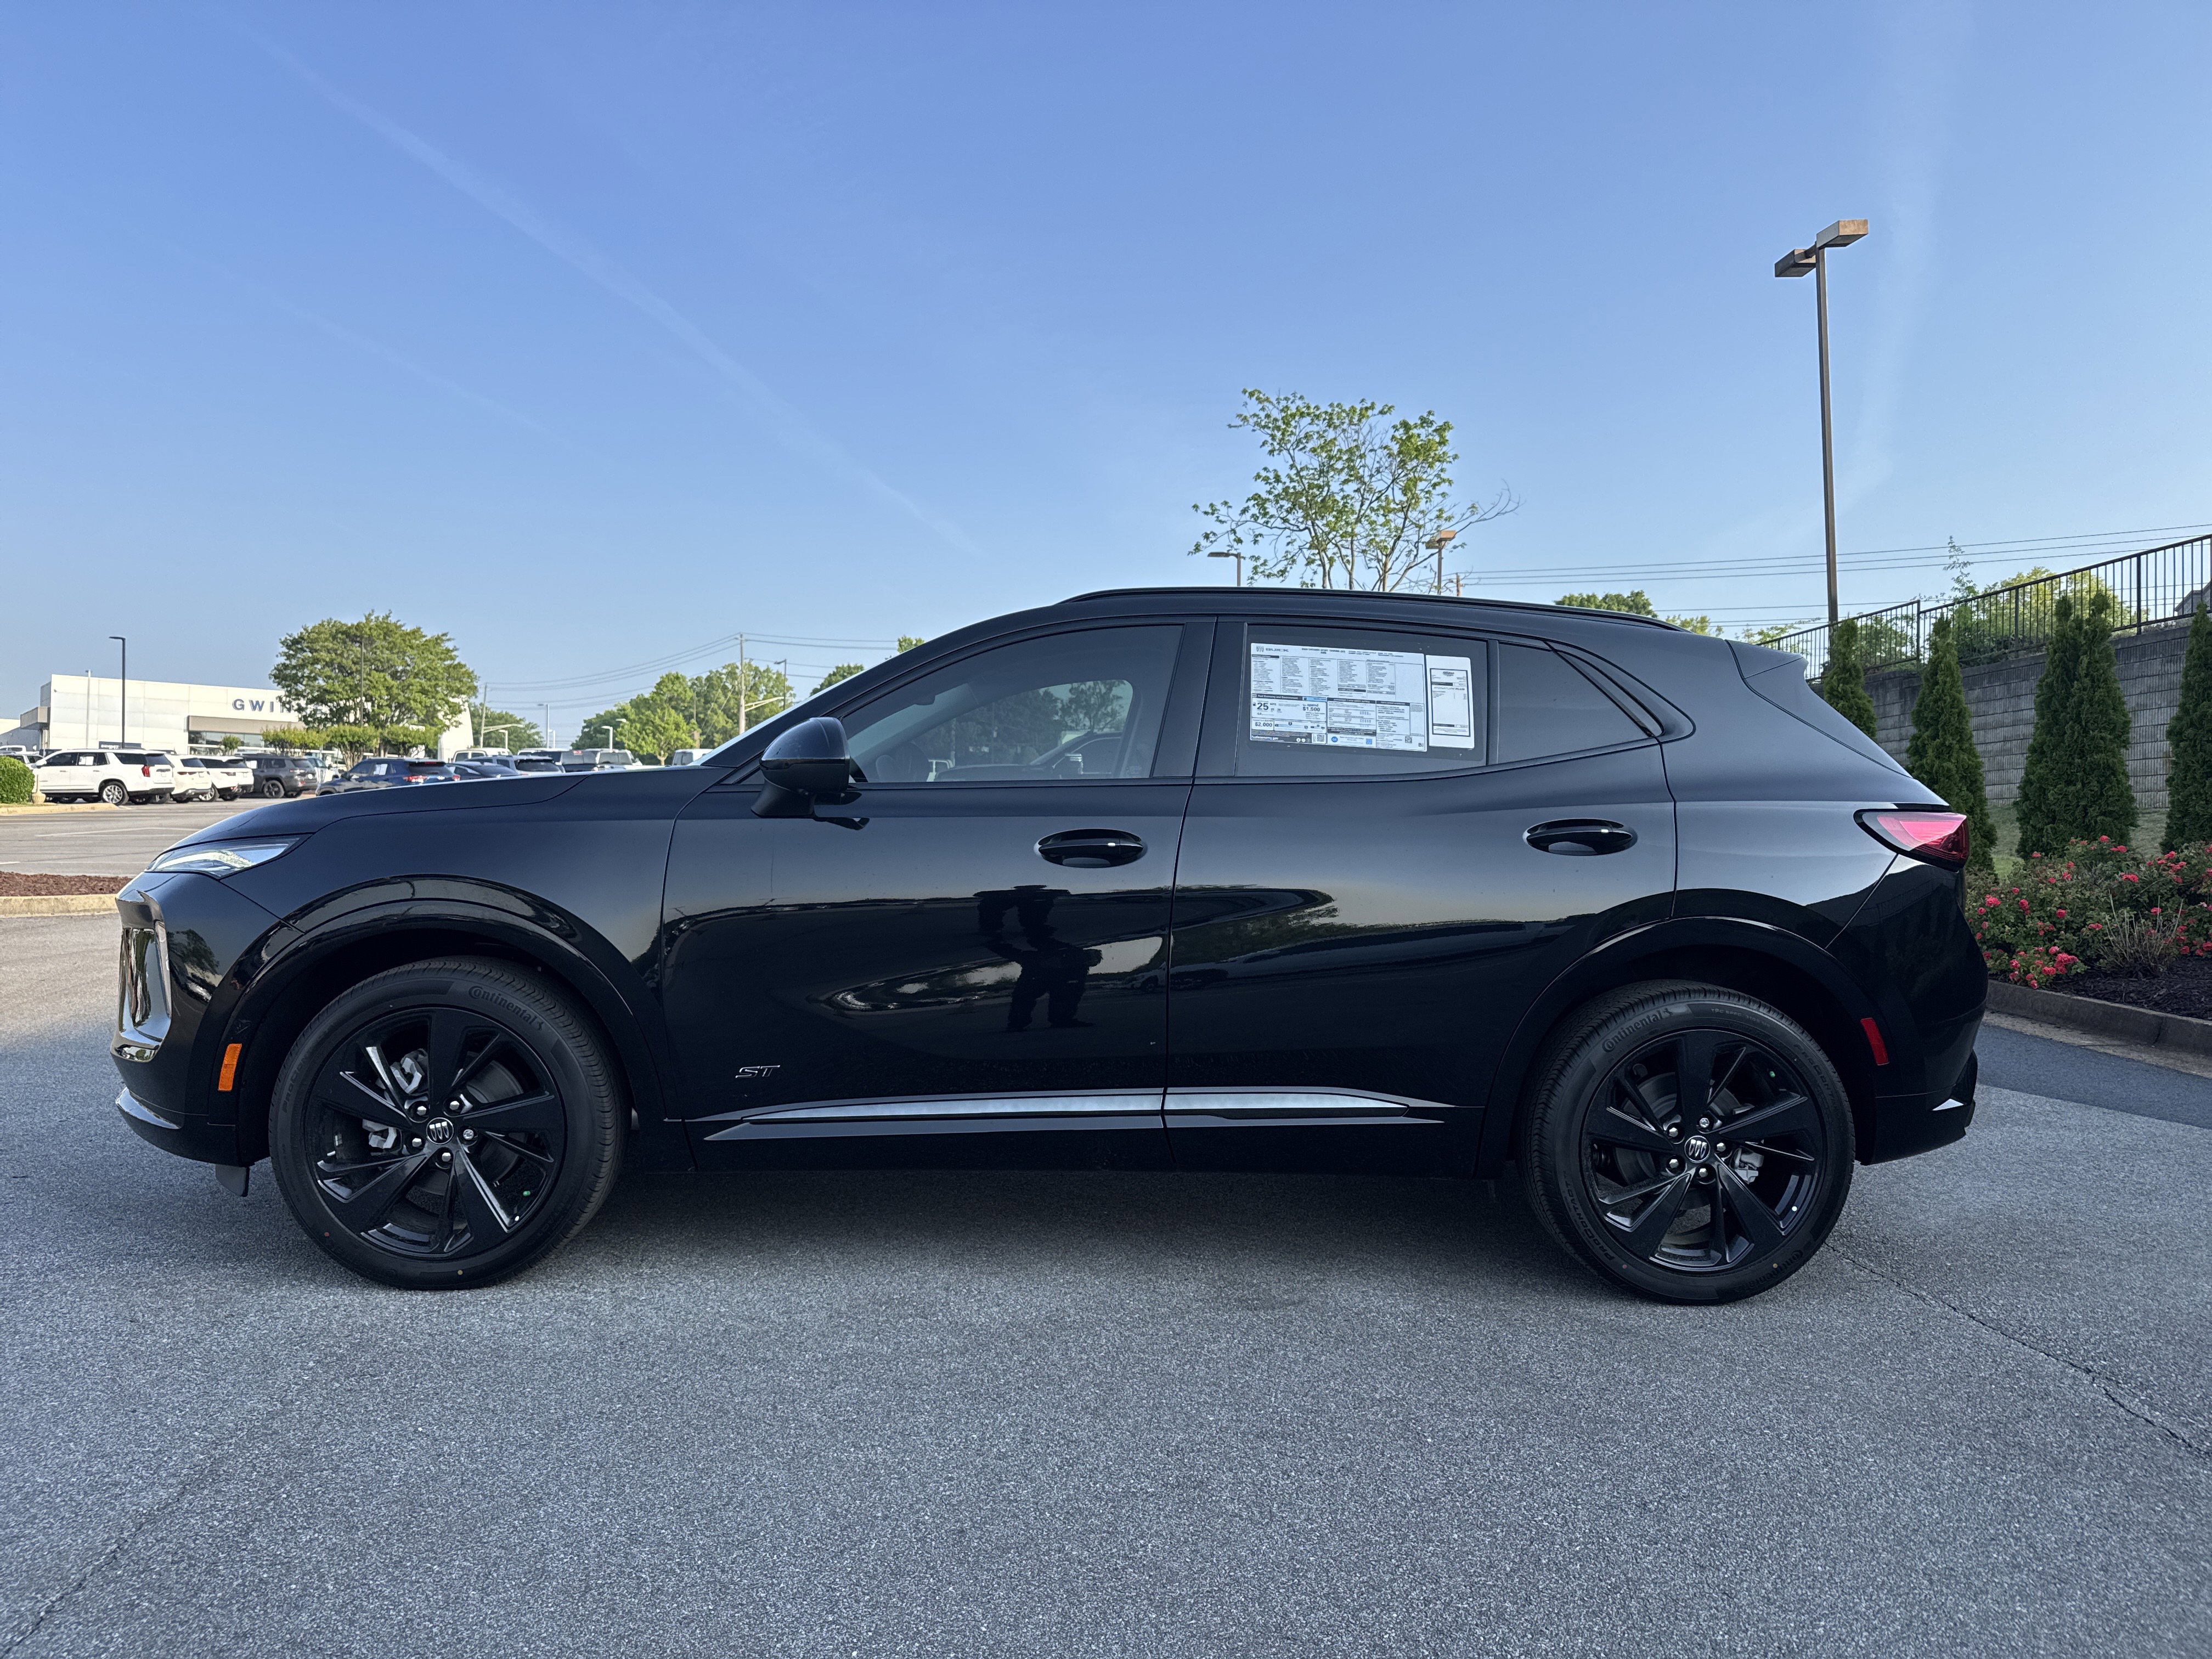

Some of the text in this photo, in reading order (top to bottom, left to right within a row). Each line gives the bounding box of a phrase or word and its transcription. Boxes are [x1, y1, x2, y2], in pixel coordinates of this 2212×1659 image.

[1257, 702, 1269, 710] 25
[469, 986, 538, 1025] Continental
[1602, 1011, 1663, 1052] Continental
[735, 1065, 780, 1078] ST
